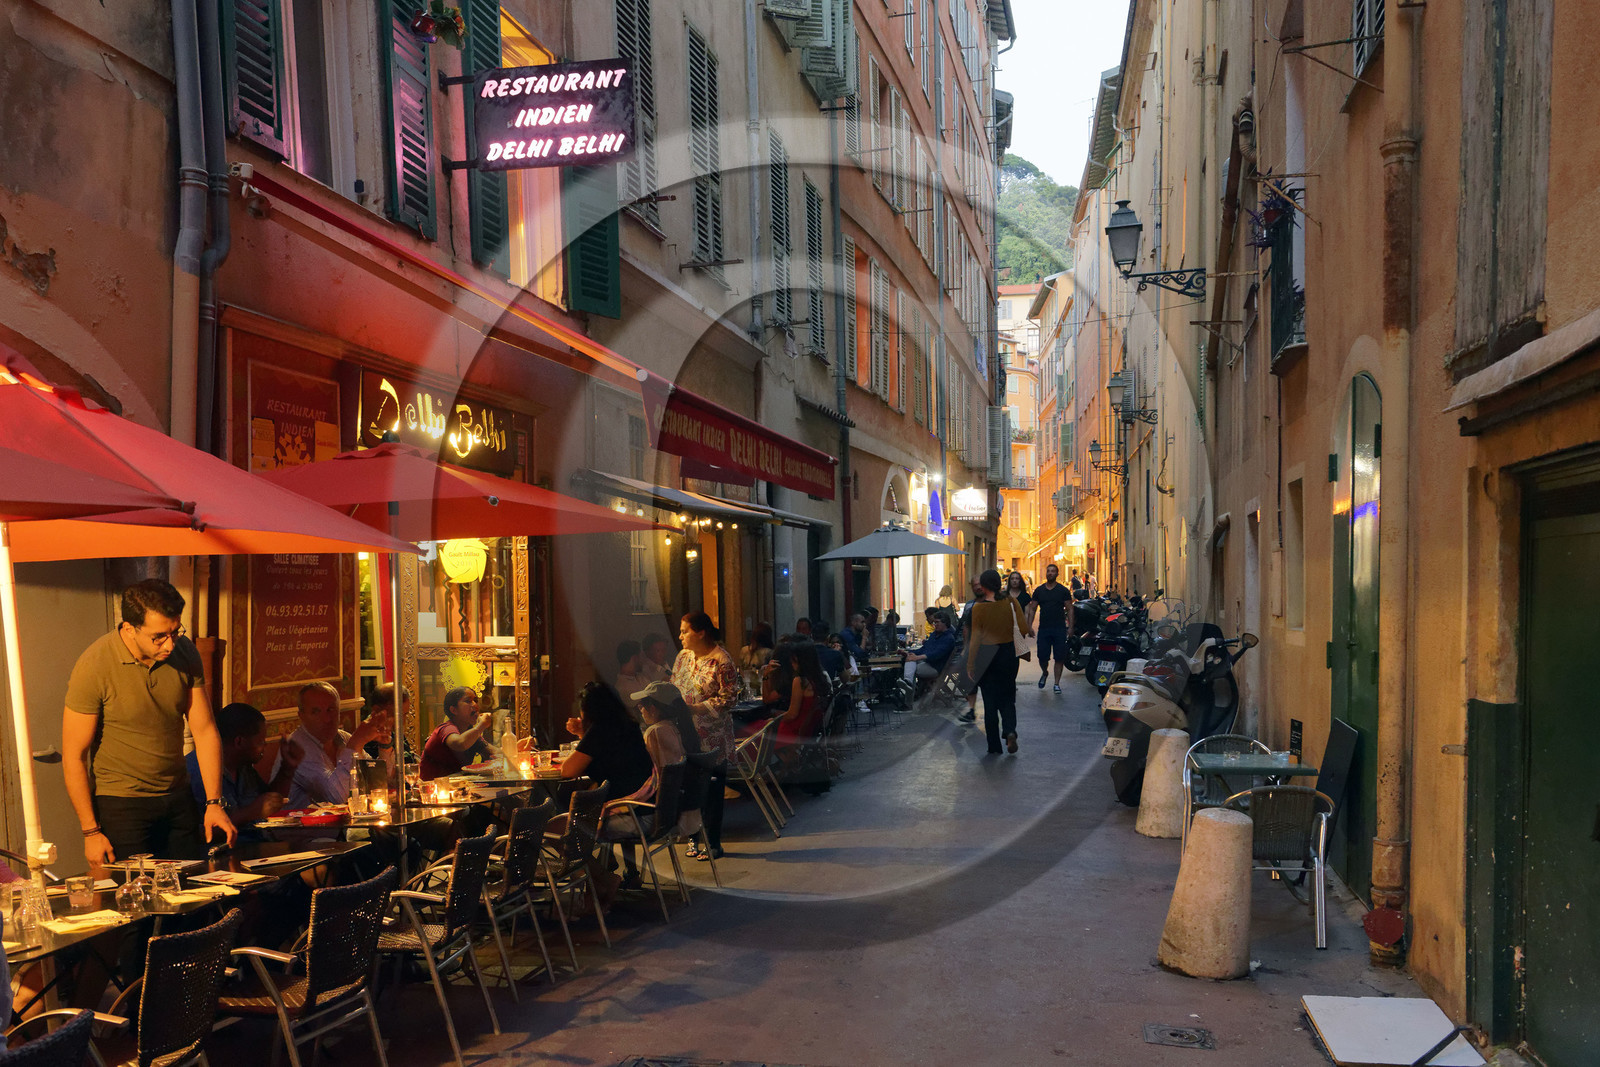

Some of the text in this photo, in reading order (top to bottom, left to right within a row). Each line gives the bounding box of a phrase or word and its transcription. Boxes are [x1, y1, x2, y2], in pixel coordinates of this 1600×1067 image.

[481, 68, 627, 99] RESTAURANT
[514, 103, 594, 128] INDIEN
[486, 133, 626, 162] DELHI BELHI
[267, 399, 327, 421] RESTAURANT
[369, 378, 507, 458] Delhi Belhi
[281, 422, 315, 438] INDIEN
[653, 403, 702, 444] RESTAURANT
[703, 424, 725, 452] INDIEN
[730, 428, 757, 469] DELHI
[760, 440, 782, 478] BELHI
[266, 626, 287, 636] Plats
[265, 642, 286, 652] Plats
[296, 640, 329, 652] Emporter
